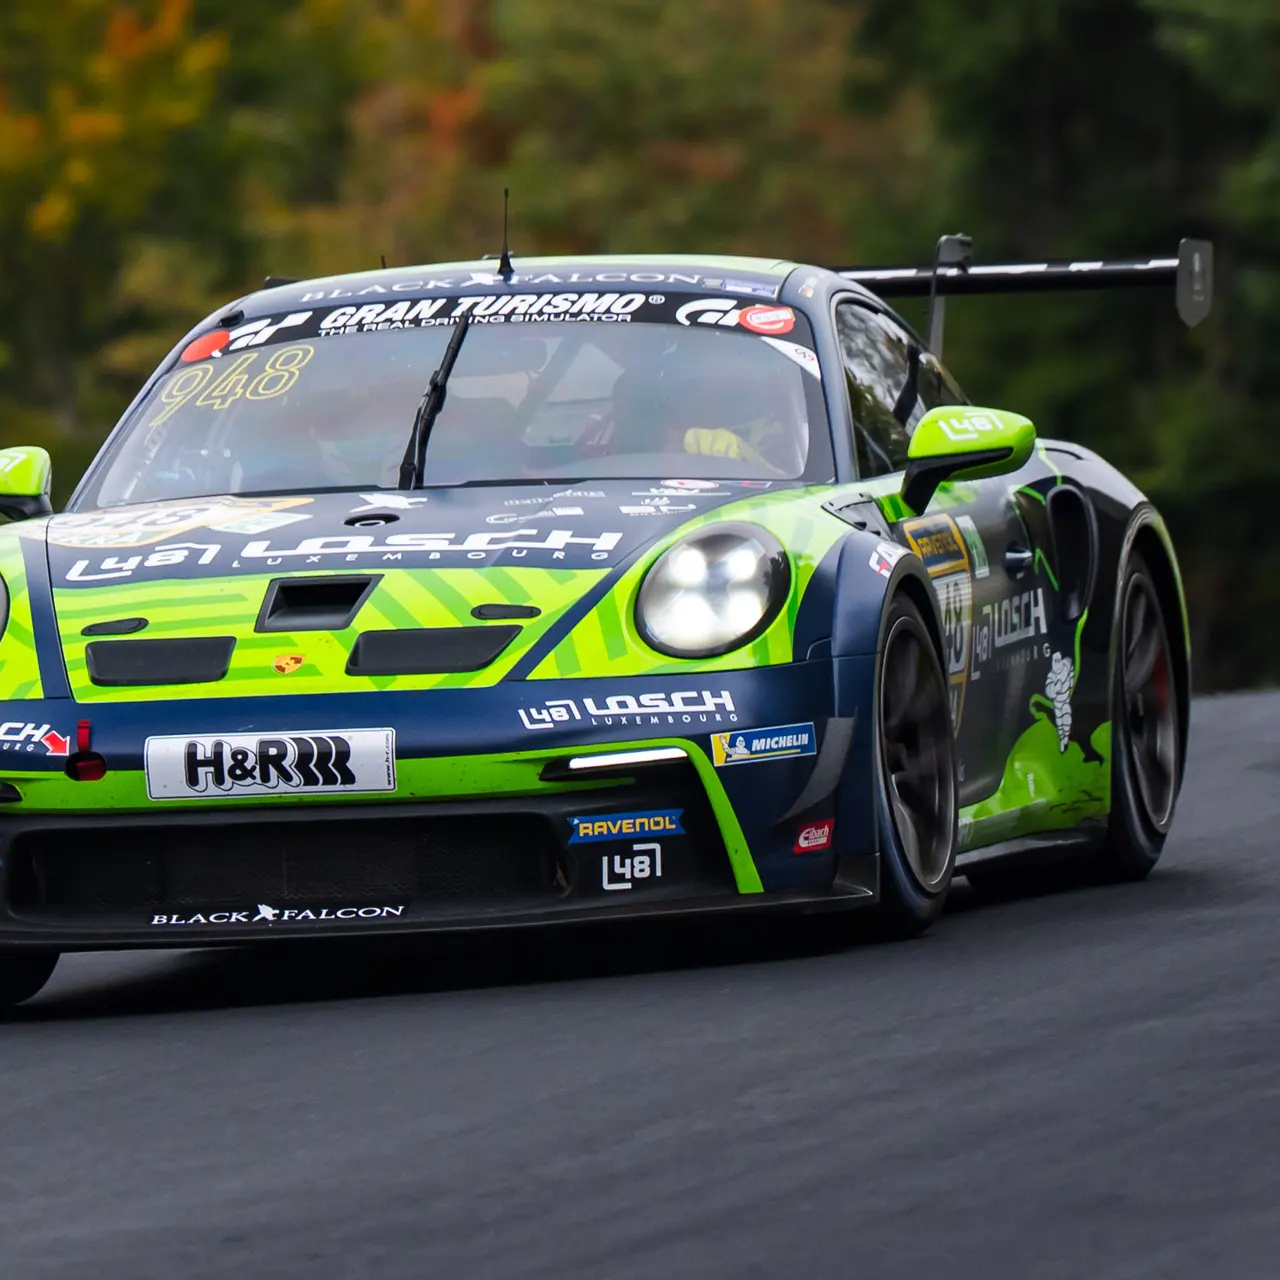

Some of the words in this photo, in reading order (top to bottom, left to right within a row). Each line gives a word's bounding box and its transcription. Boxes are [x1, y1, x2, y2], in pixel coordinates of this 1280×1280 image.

[300, 279, 455, 302] BLACK
[508, 272, 699, 285] FALCON
[320, 298, 447, 329] GRAN
[451, 293, 646, 317] TURISMO
[318, 324, 357, 338] THE
[362, 319, 415, 332] REAL
[510, 311, 632, 323] SIMULATOR
[149, 344, 315, 428] 948
[240, 528, 623, 558] LOSCH
[232, 549, 609, 569] LUXEMBOURG
[994, 587, 1048, 648] LOSCH
[582, 690, 736, 716] LOSCH
[591, 714, 739, 726] LUXEMBOURG
[751, 732, 810, 754] MICHELIN
[579, 815, 677, 838] RAVENOL
[151, 911, 249, 925] BLACK
[281, 905, 405, 920] FALCON
